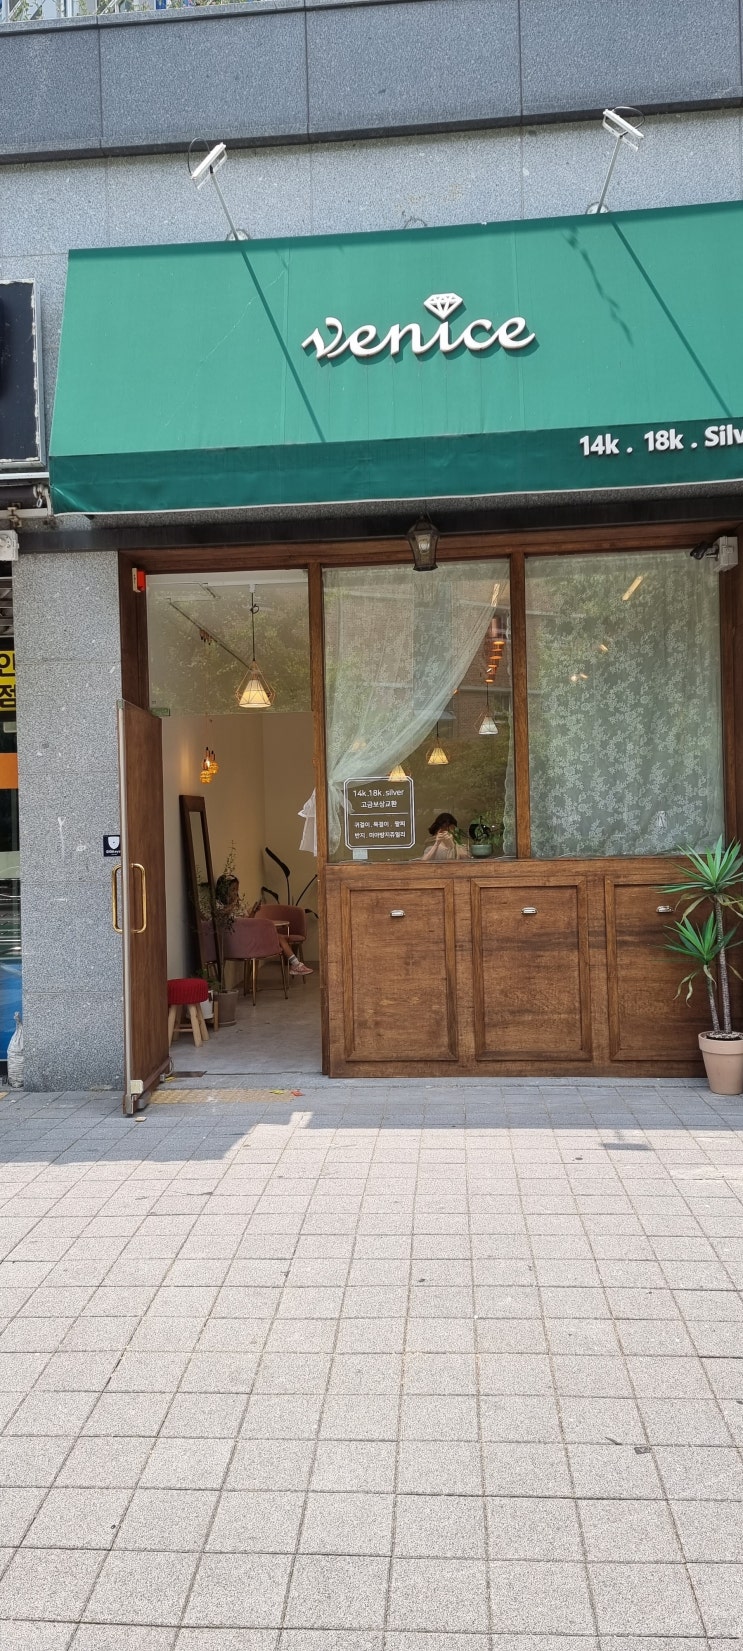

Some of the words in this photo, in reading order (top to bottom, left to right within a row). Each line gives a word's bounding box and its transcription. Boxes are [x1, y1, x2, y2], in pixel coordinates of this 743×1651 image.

[301, 316, 536, 359] venice
[579, 433, 620, 456] 14k
[644, 428, 684, 451] 18k
[360, 800, 398, 809] 고급보상교환
